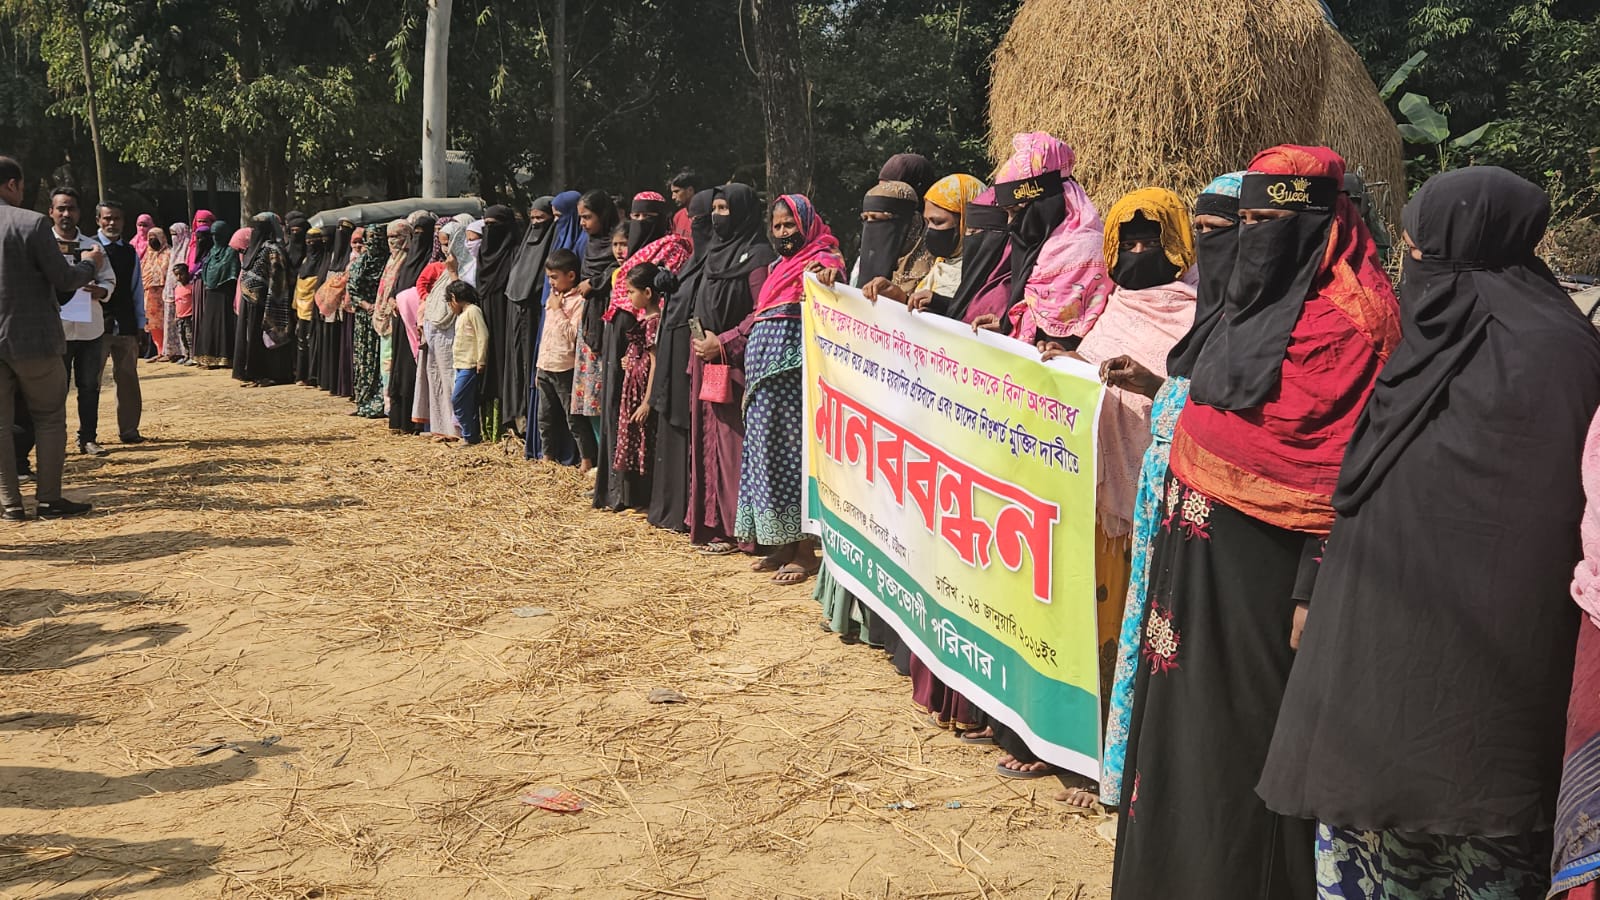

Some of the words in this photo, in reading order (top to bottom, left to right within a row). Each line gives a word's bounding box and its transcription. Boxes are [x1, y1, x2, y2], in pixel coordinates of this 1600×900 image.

[1267, 182, 1312, 205] Queen
[851, 352, 863, 372] করে
[880, 367, 886, 383] ও
[887, 369, 910, 398] হয়রানির
[910, 377, 936, 409] প্রতিবাদে
[937, 395, 953, 421] এবং
[954, 403, 978, 432] তাদের
[979, 408, 1010, 443] নিঃশর্ত
[1009, 424, 1037, 459] মুক্তির
[1040, 437, 1079, 474] দাবীতে
[870, 325, 891, 351] ঘটনায়
[892, 330, 912, 361] নিরীহ
[913, 344, 928, 371] বৃদ্ধা
[930, 347, 960, 383] নারীসহ
[961, 367, 968, 384] ৩
[972, 368, 1000, 397] জনকে
[1002, 374, 1025, 408] বিনা
[1027, 391, 1080, 432] অপরাধে
[815, 377, 1059, 603] মানববন্ধন
[875, 562, 927, 632] ভুক্তভোগী
[931, 618, 995, 681] পরিবার
[935, 575, 958, 601] তারিখ
[968, 595, 980, 614] ২৪
[983, 603, 1017, 636] জানুয়ারি
[1019, 627, 1058, 667] ২০২৬ইং
